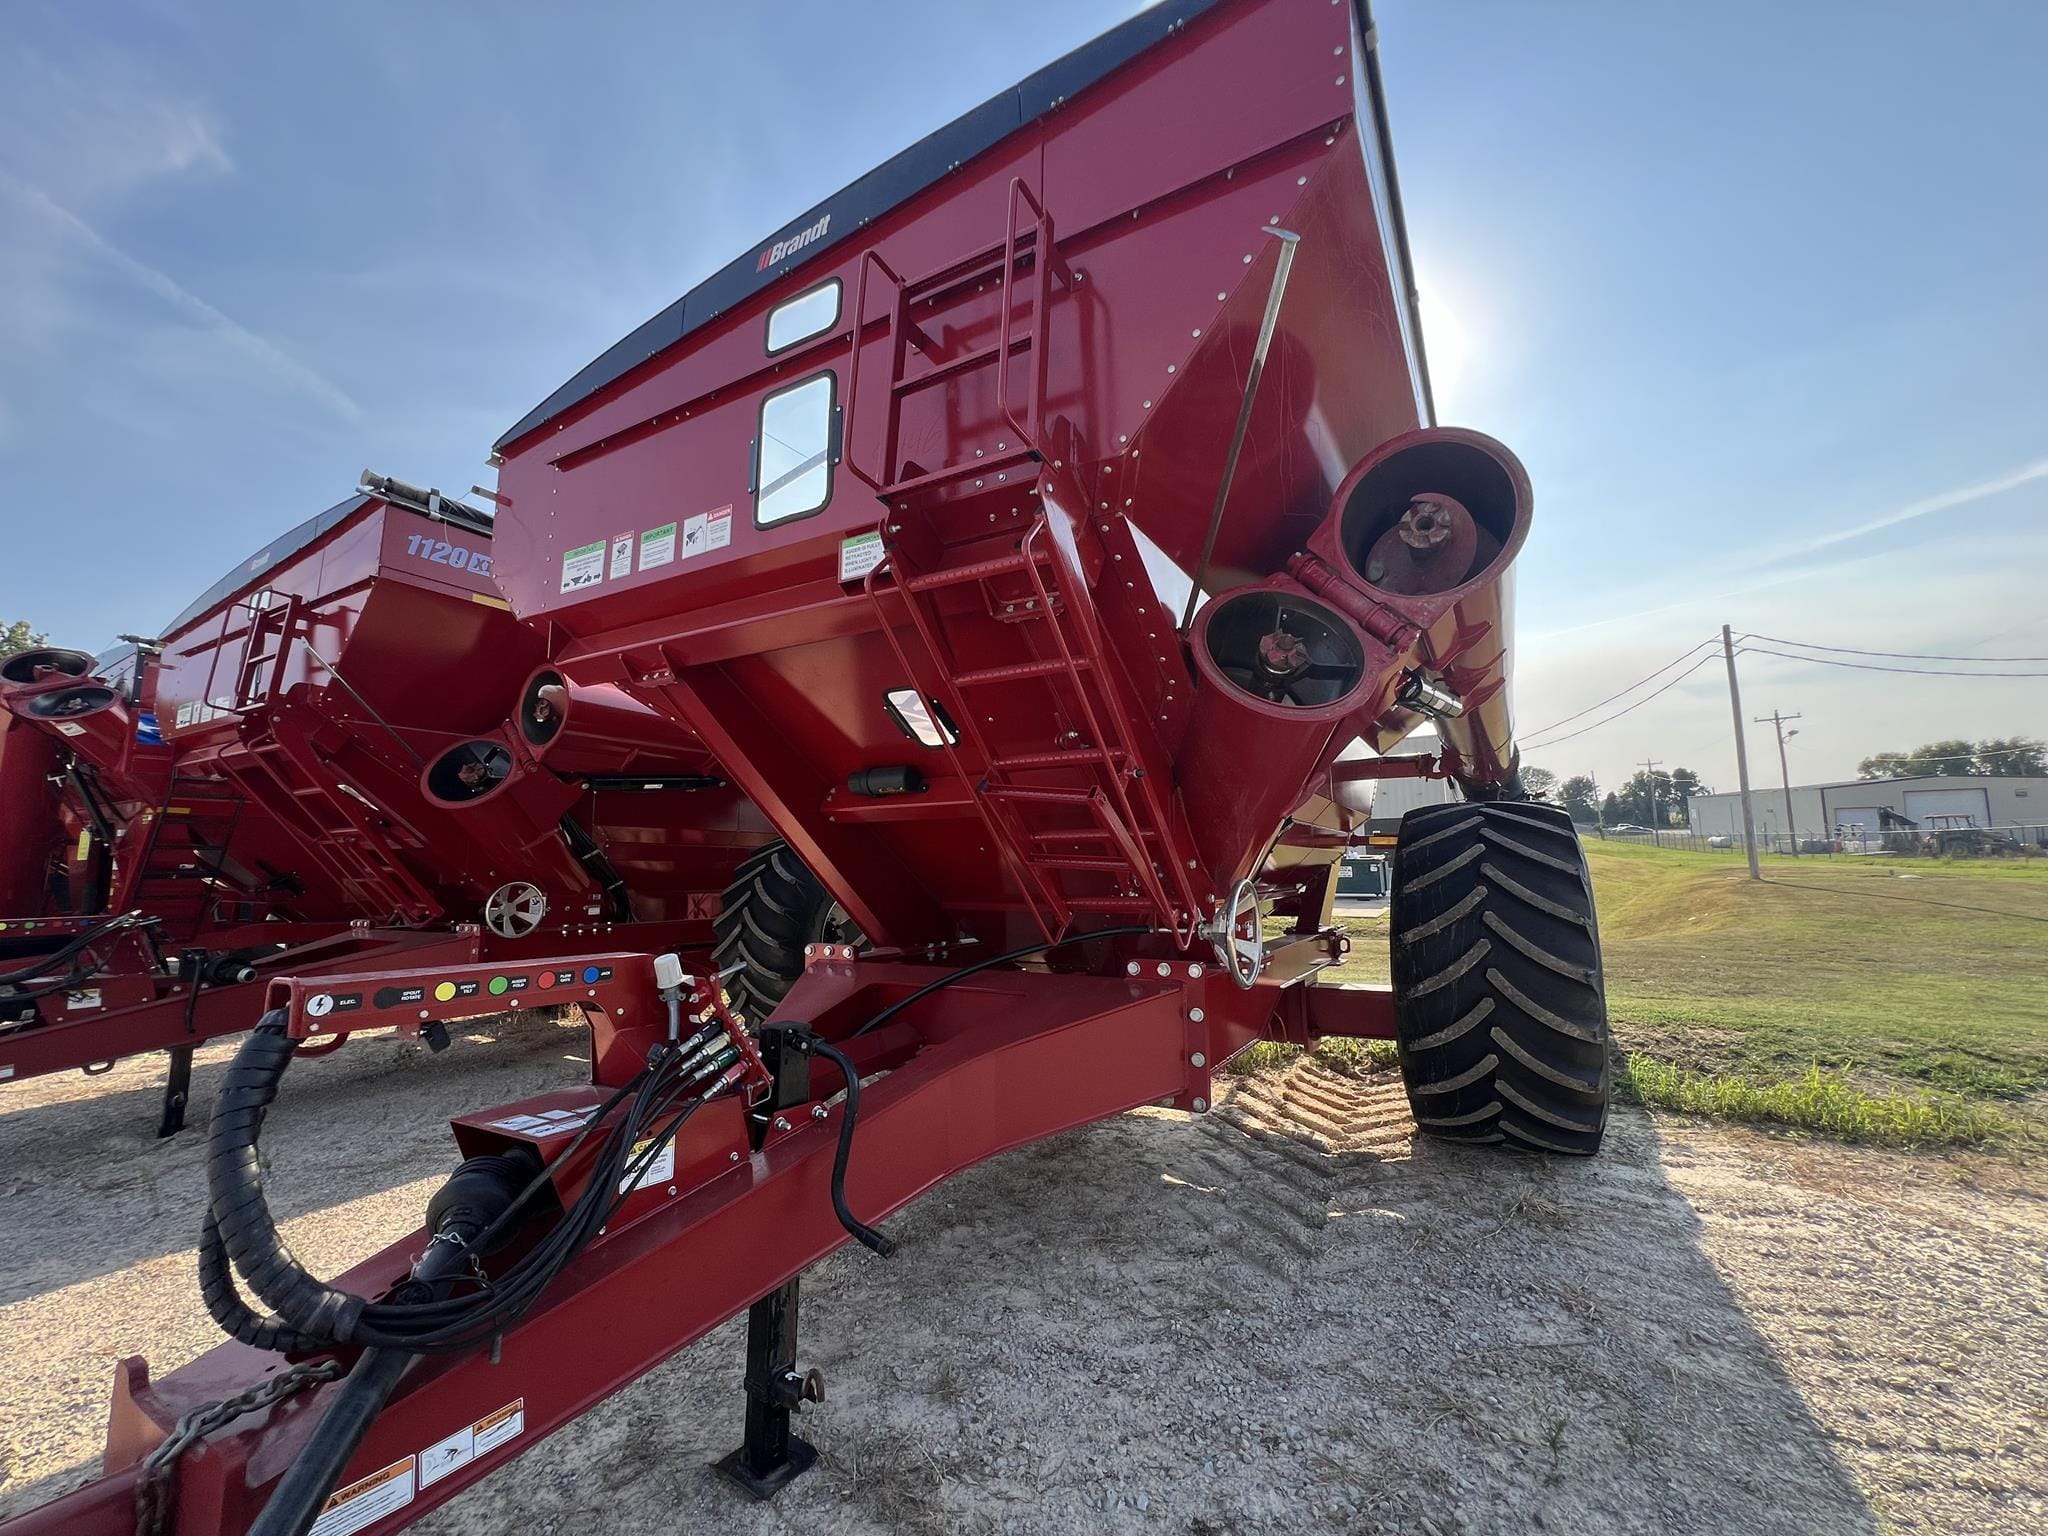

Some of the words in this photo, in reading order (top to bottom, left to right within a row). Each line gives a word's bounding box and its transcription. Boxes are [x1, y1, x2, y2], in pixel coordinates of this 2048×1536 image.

[768, 214, 831, 266] Brandt
[643, 526, 674, 541] IMPORTANT
[407, 534, 469, 569] 1120
[845, 551, 872, 561] RETRACTED
[341, 1471, 391, 1501] WARNING
